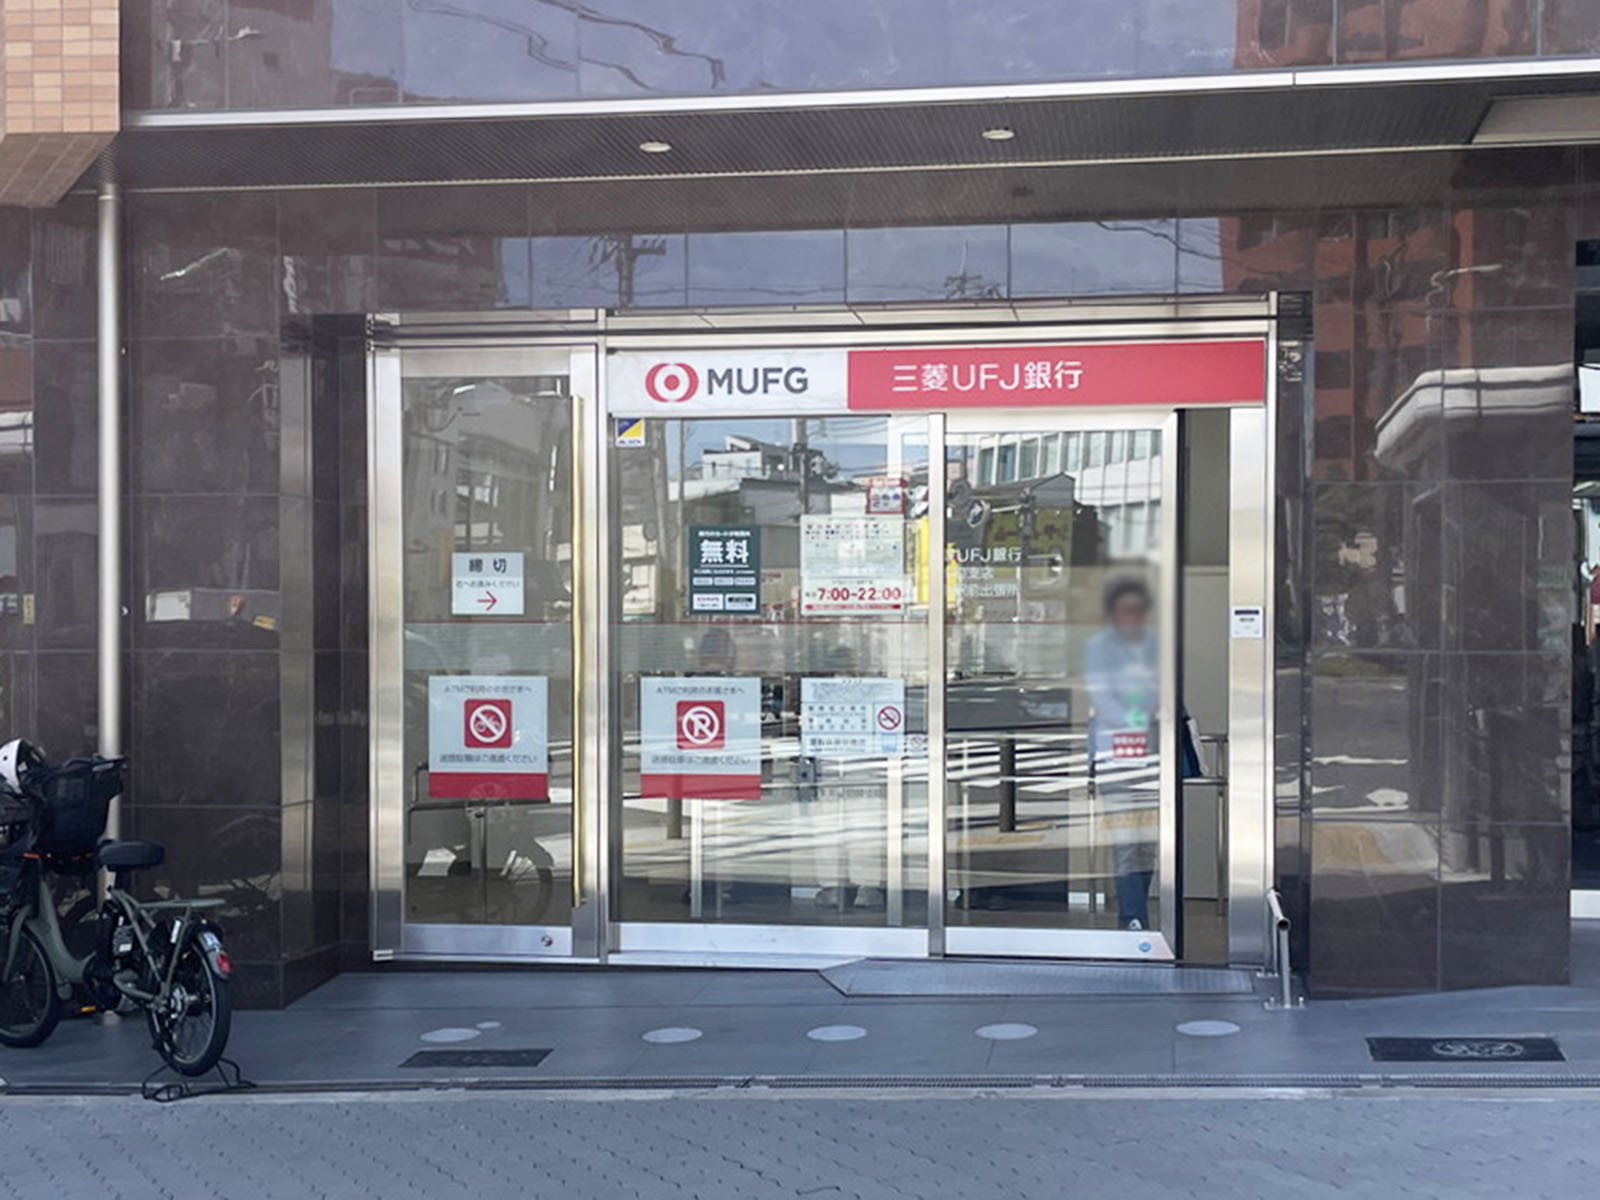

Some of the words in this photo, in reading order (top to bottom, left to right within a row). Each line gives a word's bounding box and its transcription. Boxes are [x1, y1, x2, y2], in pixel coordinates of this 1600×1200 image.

[706, 366, 808, 396] MUFG
[891, 361, 1083, 394] 三菱UFJ銀行
[699, 540, 750, 564] 無料
